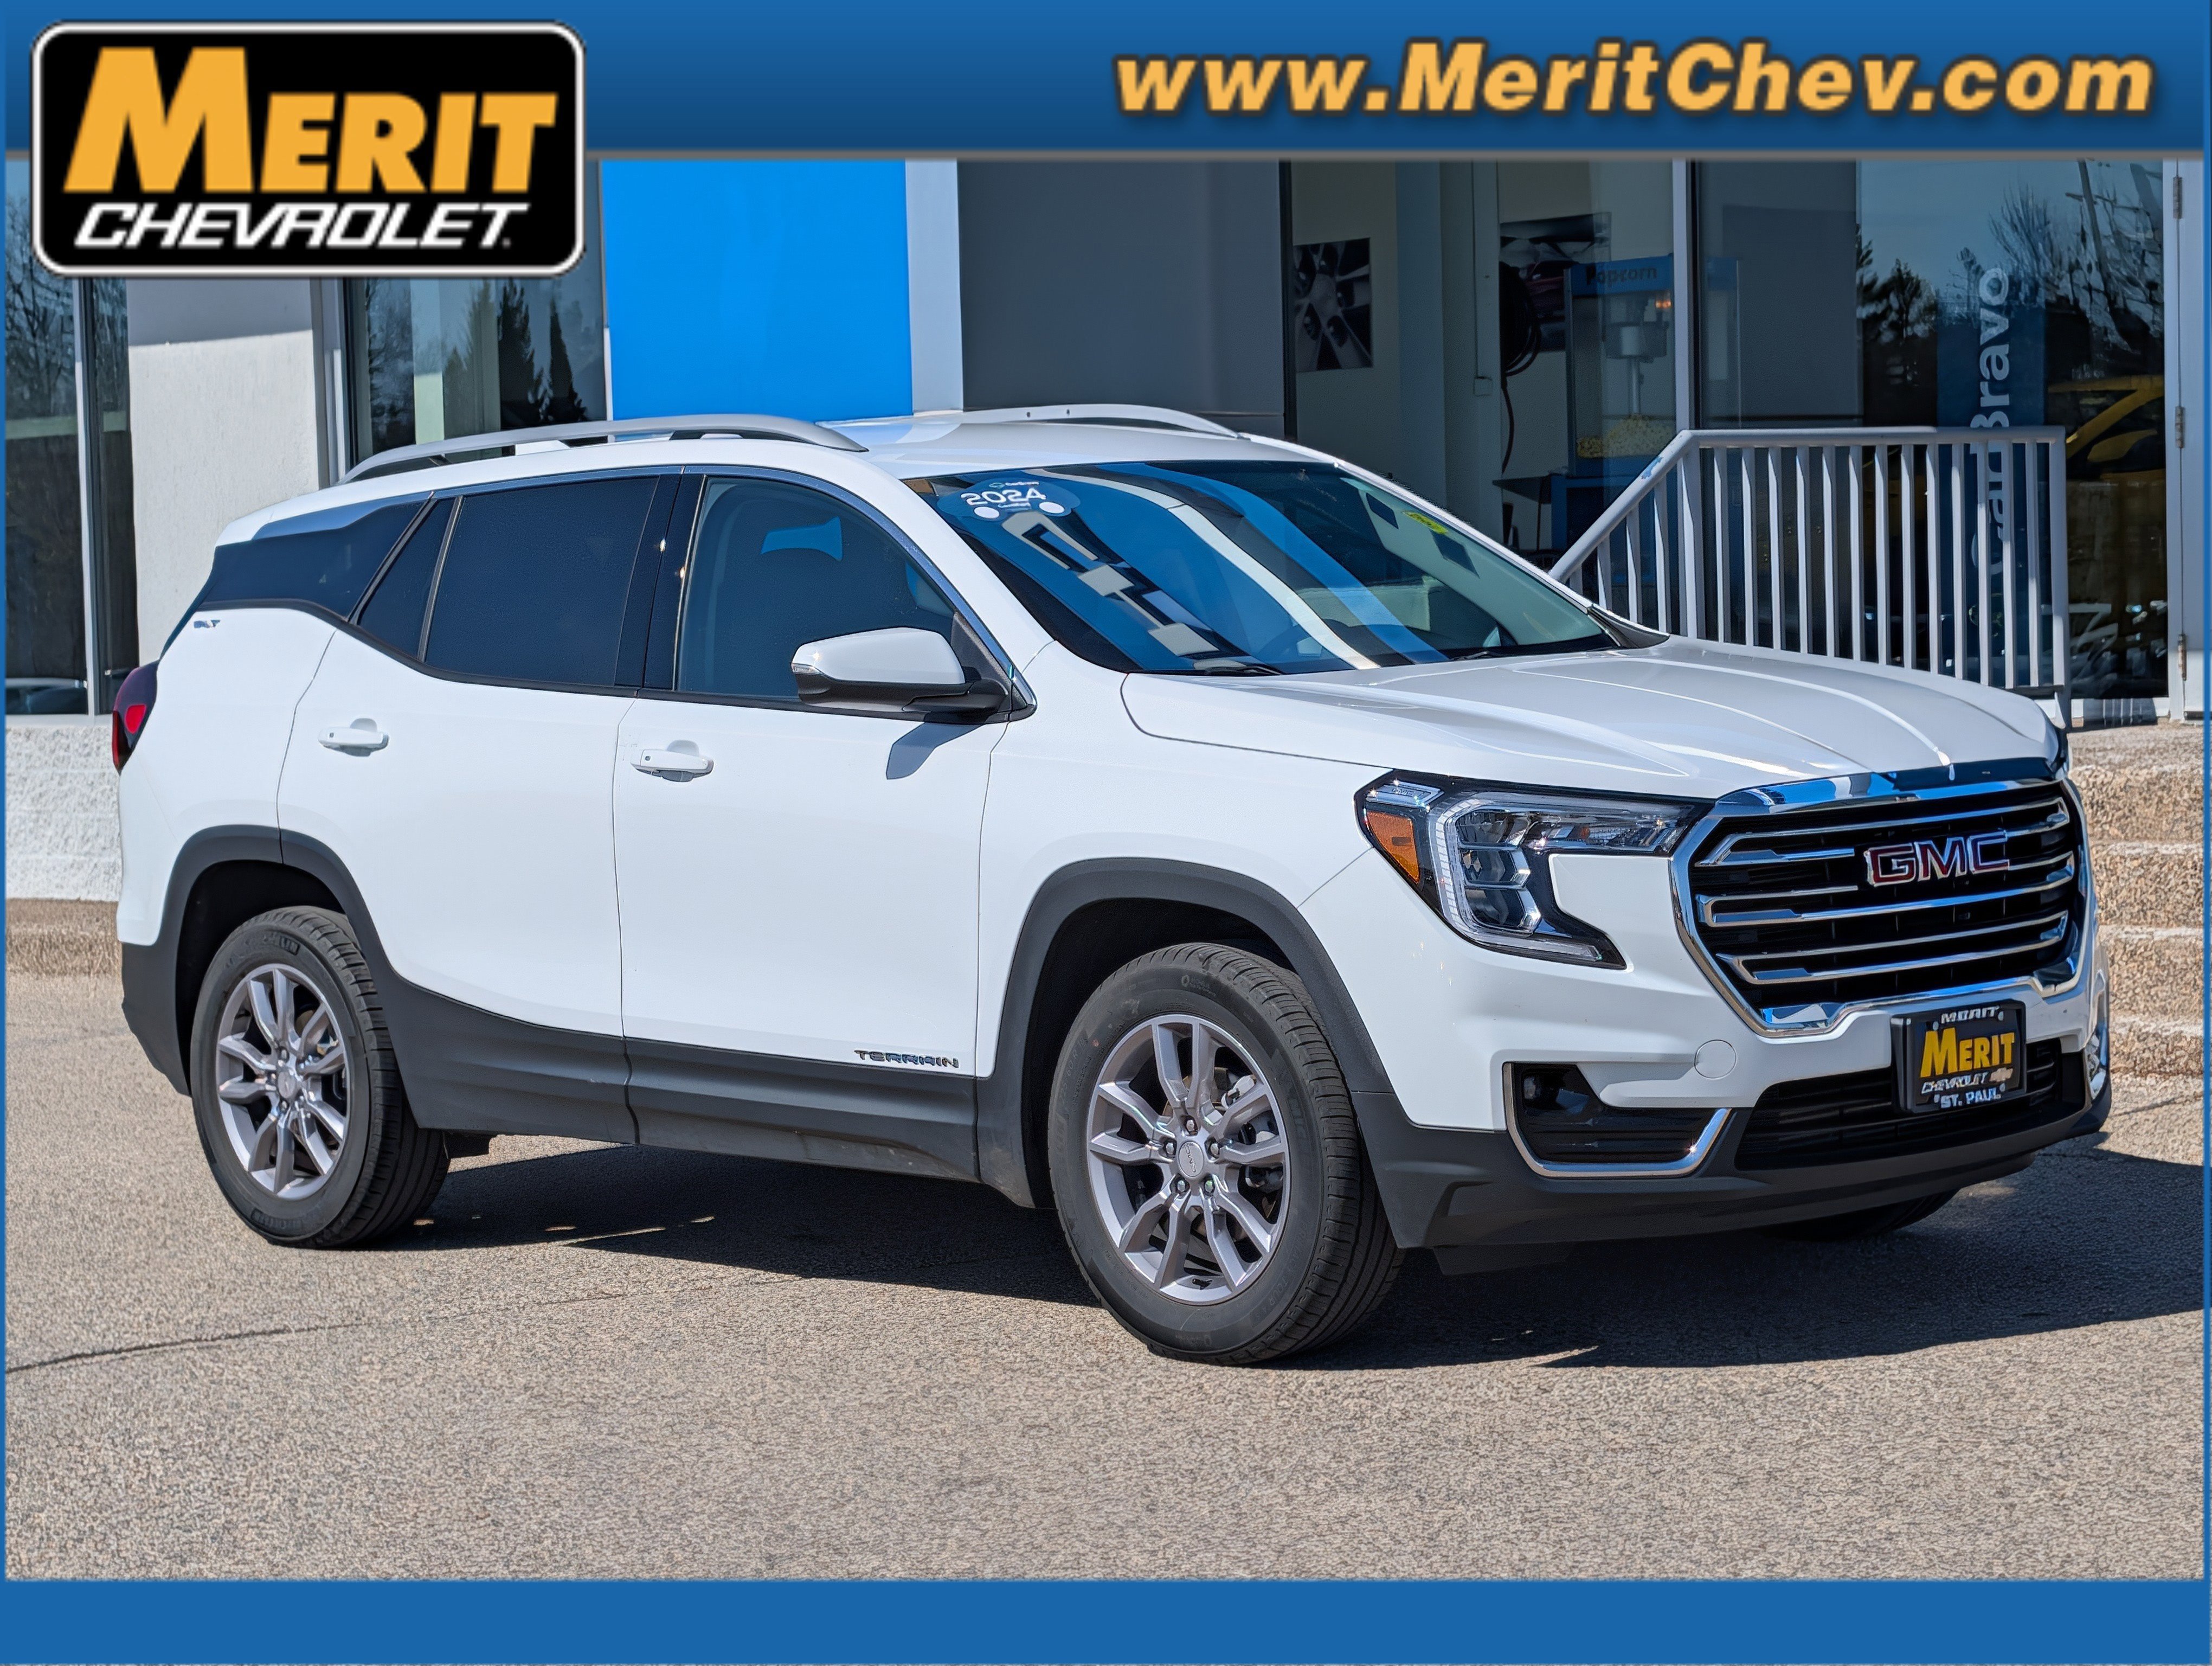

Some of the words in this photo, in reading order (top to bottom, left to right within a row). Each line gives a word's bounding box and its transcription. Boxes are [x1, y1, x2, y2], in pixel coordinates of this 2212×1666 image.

[1586, 266, 1657, 287] Popcorn
[961, 488, 1046, 505] 2024
[1864, 830, 2009, 887] GMC
[854, 1050, 959, 1068] TERRAIN
[1920, 1028, 2015, 1078] MERIT
[1940, 1094, 1963, 1108] ST.
[1965, 1087, 2001, 1104] PAUL
